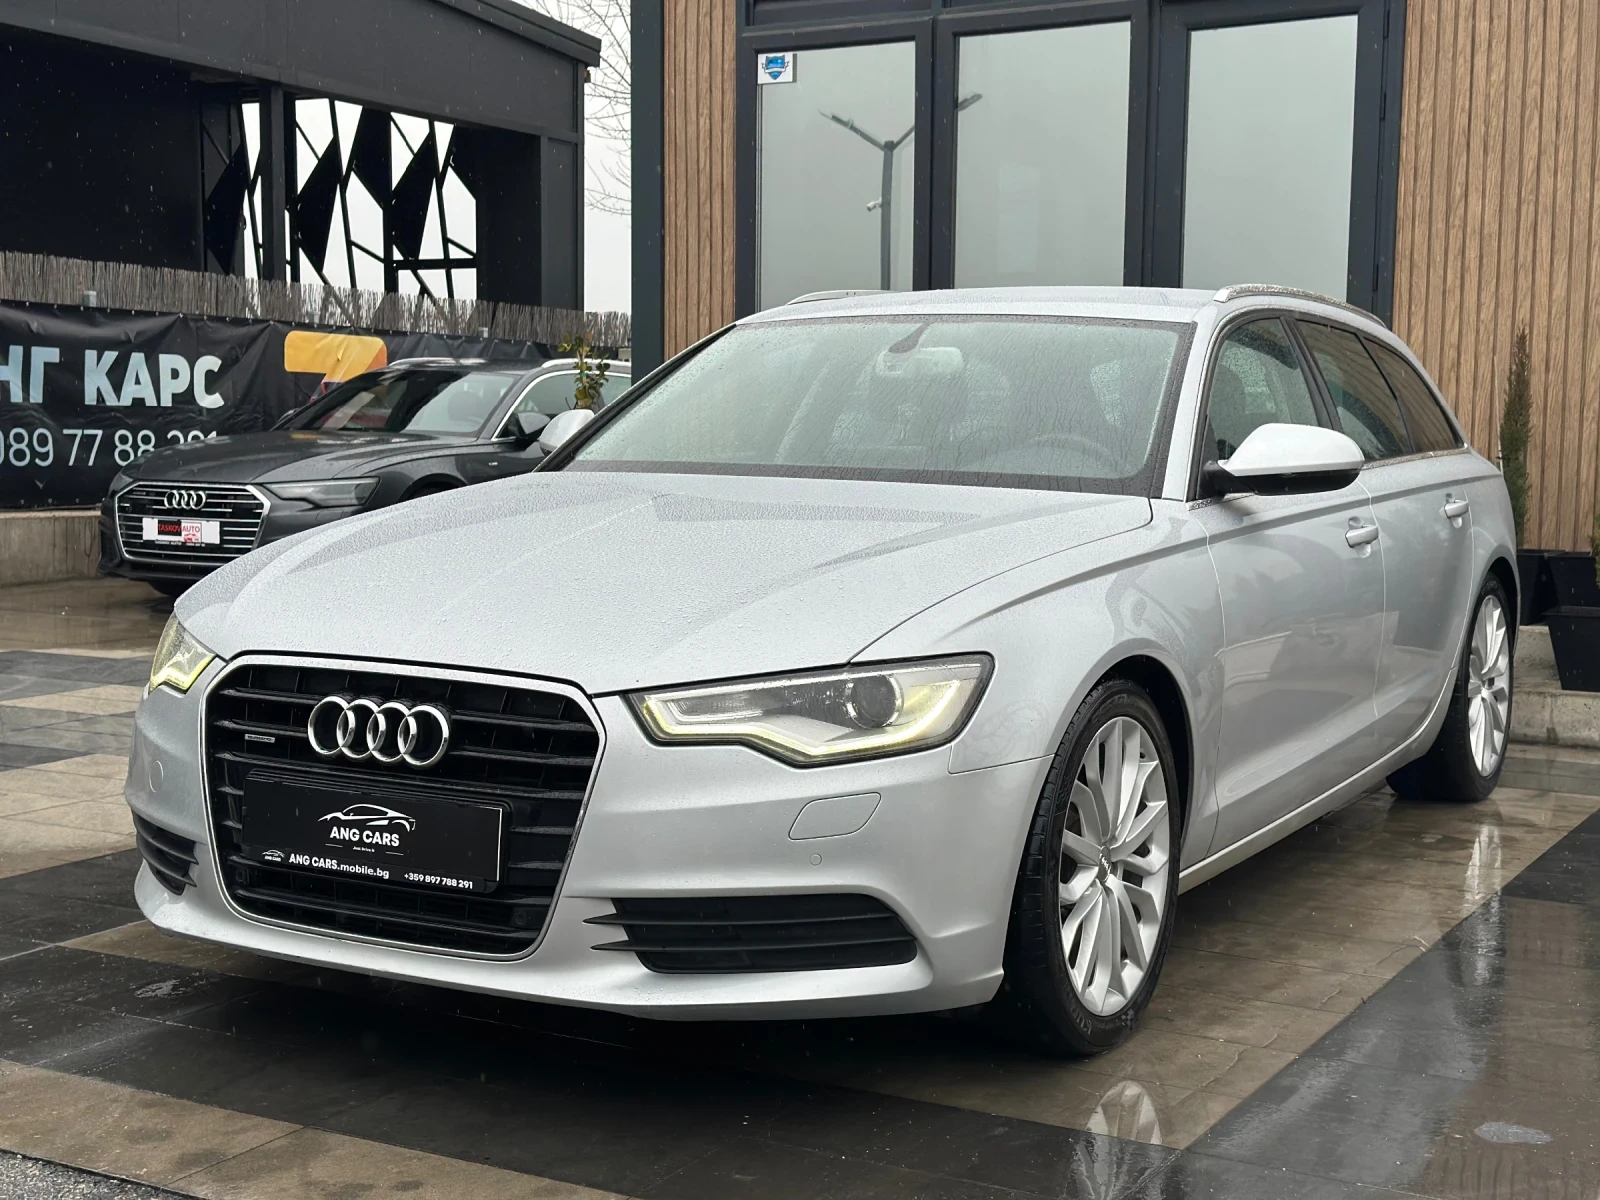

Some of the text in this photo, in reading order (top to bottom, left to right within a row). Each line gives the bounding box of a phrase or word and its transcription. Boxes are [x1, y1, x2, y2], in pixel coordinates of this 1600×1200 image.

[84, 349, 225, 409] КАРС
[0, 427, 54, 467] 89
[62, 428, 103, 467] 77
[182, 525, 201, 533] AUTO
[329, 826, 400, 848] ANG CARS
[289, 853, 390, 880] ANG CARS.mobile.bg
[404, 872, 473, 889] +359 897 788 291
